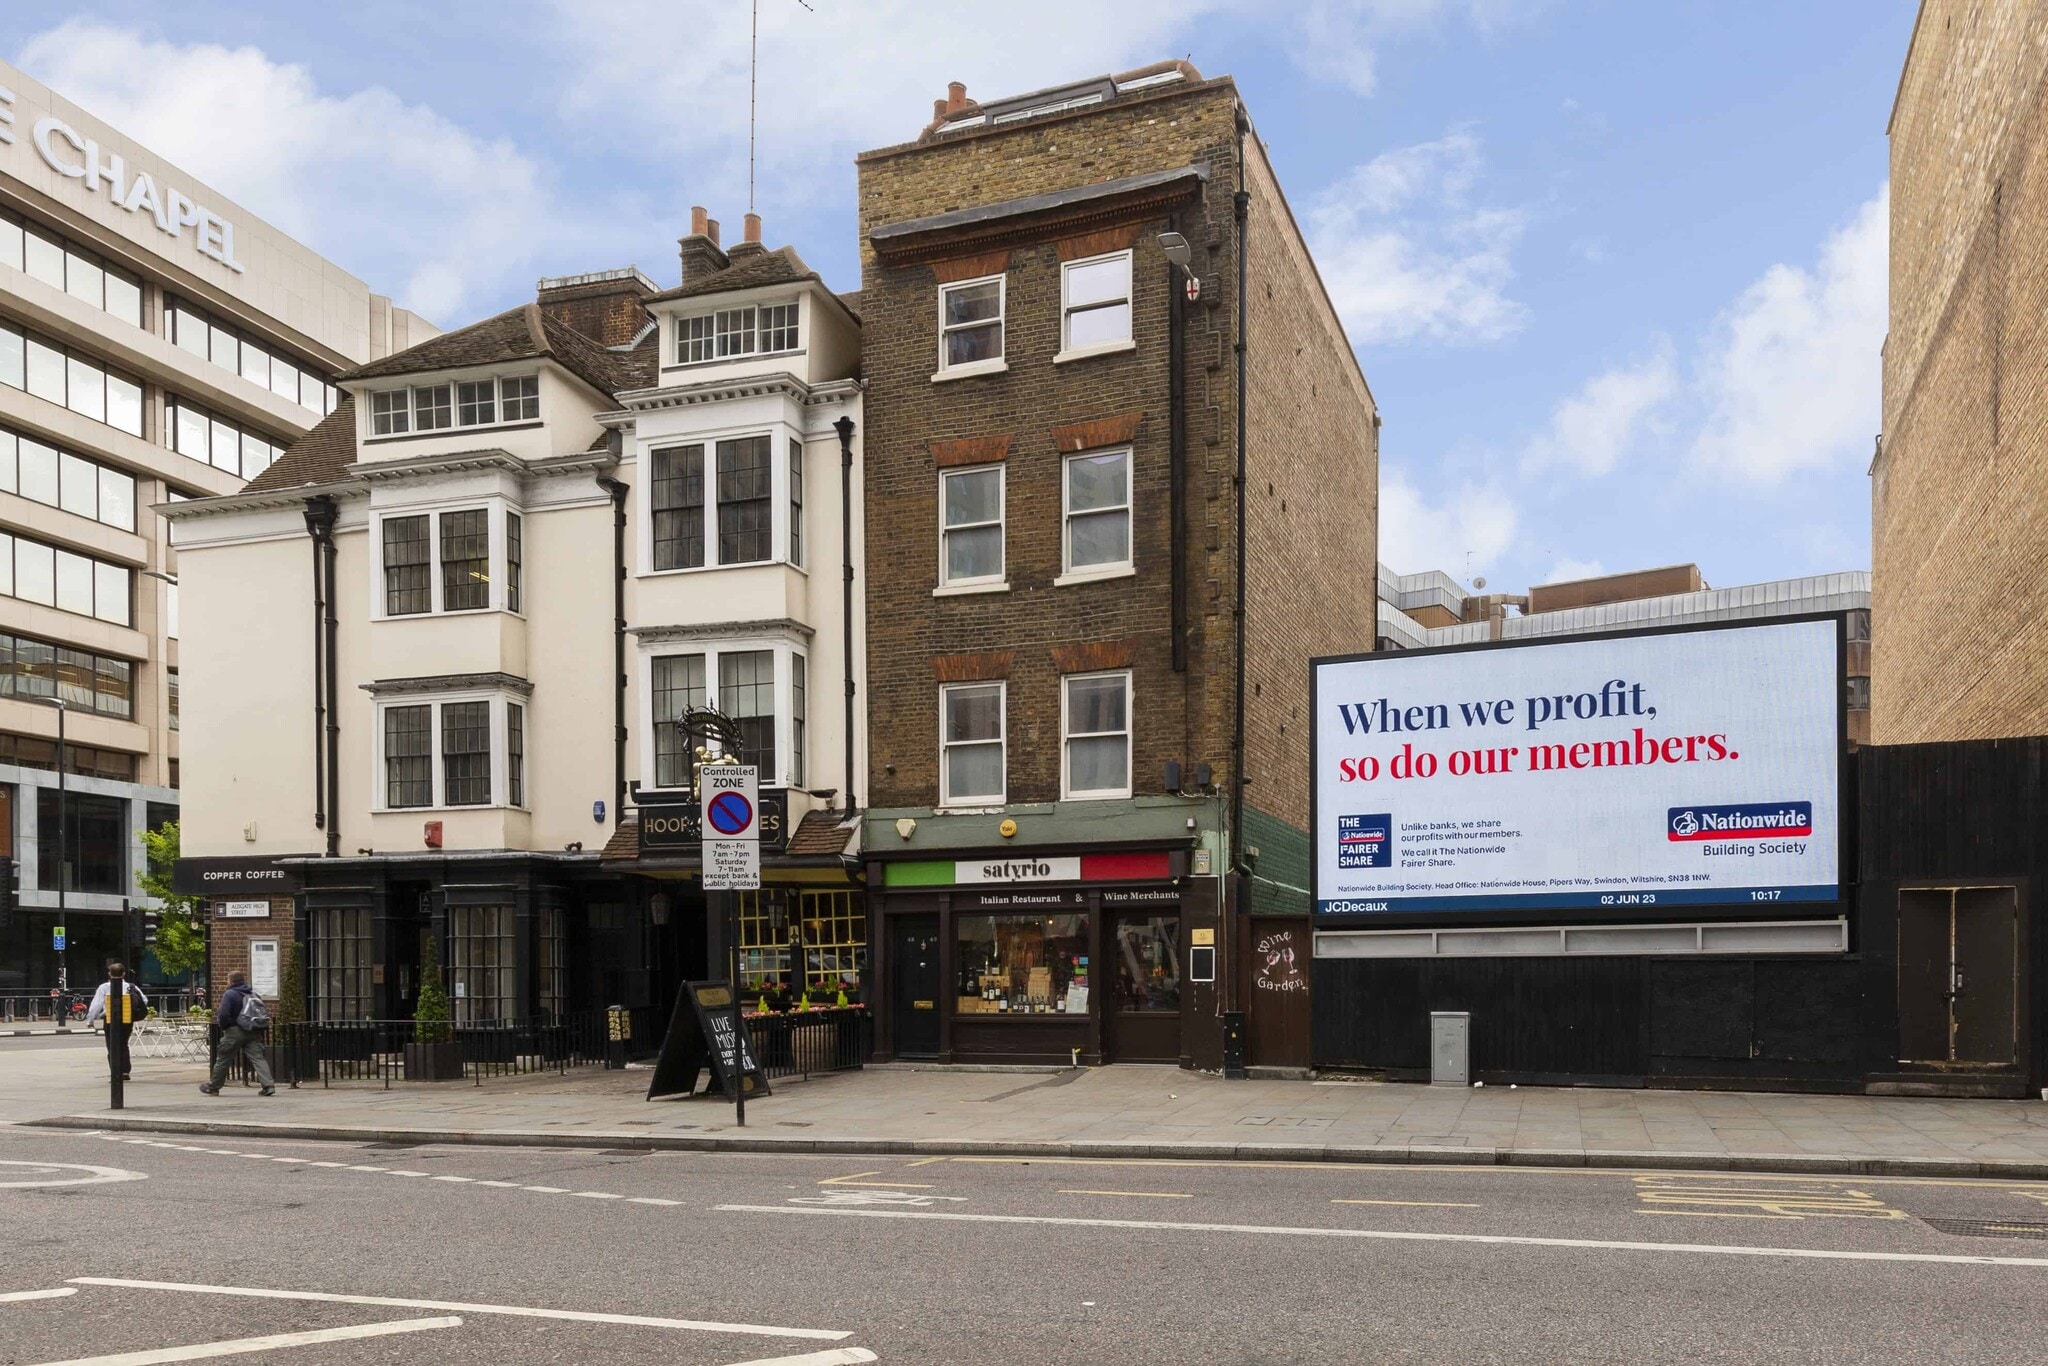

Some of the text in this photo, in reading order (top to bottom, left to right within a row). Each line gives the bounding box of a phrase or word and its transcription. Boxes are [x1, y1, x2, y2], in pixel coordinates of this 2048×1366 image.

[33, 117, 244, 274] CHAPEL
[1338, 679, 1657, 735] When we profit,
[1339, 728, 1740, 783] so do our members.
[702, 767, 755, 776] Controlled
[713, 778, 745, 789] ZONE
[1340, 818, 1360, 828] THE
[1401, 822, 1428, 832] Unlike
[1430, 821, 1459, 831] banks,
[1476, 820, 1502, 828] share
[1701, 810, 1807, 831] Nationwide
[1350, 831, 1383, 839] Nationwide
[1416, 833, 1444, 843] profits
[1444, 832, 1463, 841] with
[1479, 830, 1523, 839] members.
[1340, 844, 1379, 855] FAIRER
[1440, 848, 1455, 856] The
[1457, 845, 1506, 855] Nationwide
[1703, 842, 1807, 857] Building Society
[715, 858, 747, 866] Saturday
[1340, 856, 1373, 866] SHARE
[1401, 859, 1456, 868] Fairer Share.
[203, 870, 285, 880] COPPER COFFEE
[983, 858, 1051, 882] satyrio
[704, 873, 730, 881] except
[729, 880, 759, 888] holidays
[1338, 885, 1375, 893] Nationwide
[1377, 883, 1405, 892] Building
[1406, 883, 1434, 891] Society.
[1455, 881, 1479, 889] Office:
[1480, 879, 1521, 888] Nationwide
[1549, 878, 1573, 886] Pipers
[1574, 877, 1592, 885] Way,
[1594, 877, 1629, 885] Swindon,
[1630, 875, 1666, 884] Wiltshire,
[981, 890, 1180, 904] Italian Restaurant & Wine Merchants
[1325, 890, 1782, 913] JCDecaux 02 JUN 23 10:17
[1257, 931, 1292, 953] Wine
[711, 1016, 732, 1032] LIVE
